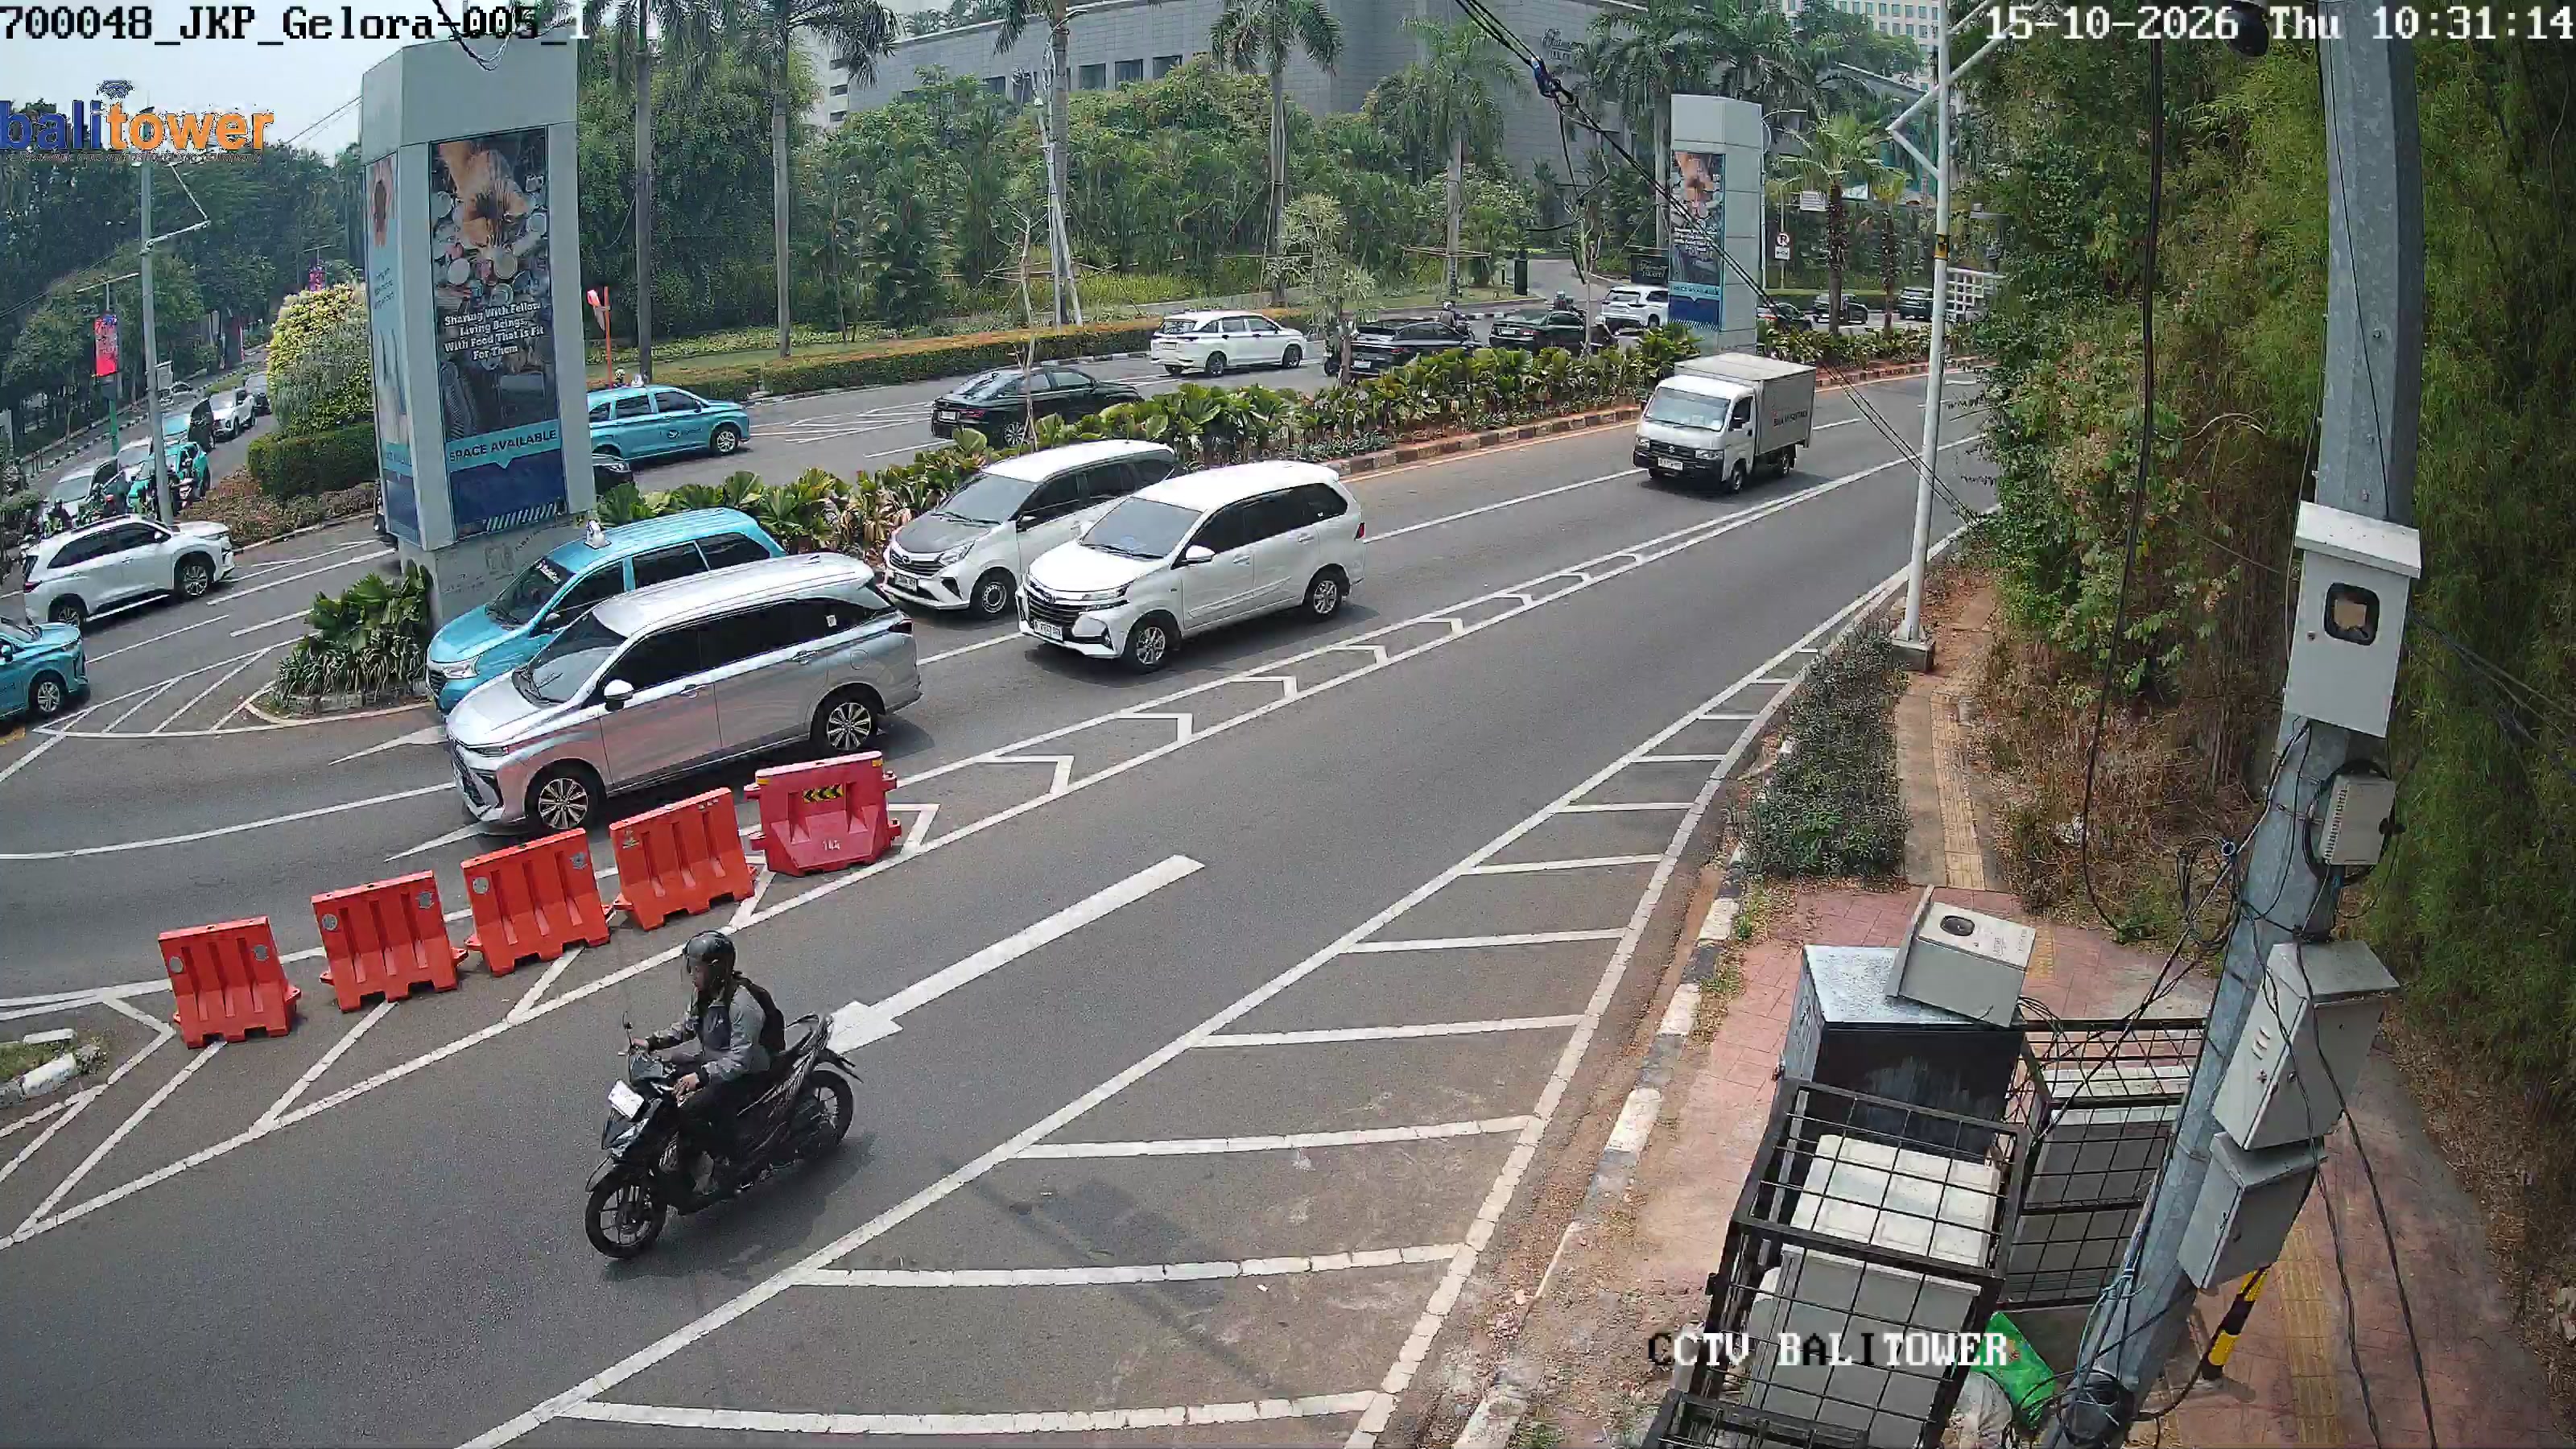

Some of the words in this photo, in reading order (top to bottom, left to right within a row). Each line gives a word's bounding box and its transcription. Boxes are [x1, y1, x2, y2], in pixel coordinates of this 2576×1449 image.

[444, 312, 483, 326] Sharing
[485, 306, 510, 319] With
[511, 301, 542, 313] Fellow
[444, 340, 469, 353] With
[470, 335, 494, 348] Food
[495, 331, 518, 343] That
[530, 325, 544, 336] Fit
[460, 323, 491, 336] Living
[473, 350, 489, 360] For
[492, 345, 518, 357] Them
[449, 444, 486, 461] SPACE
[491, 430, 557, 452] AVAILABLE
